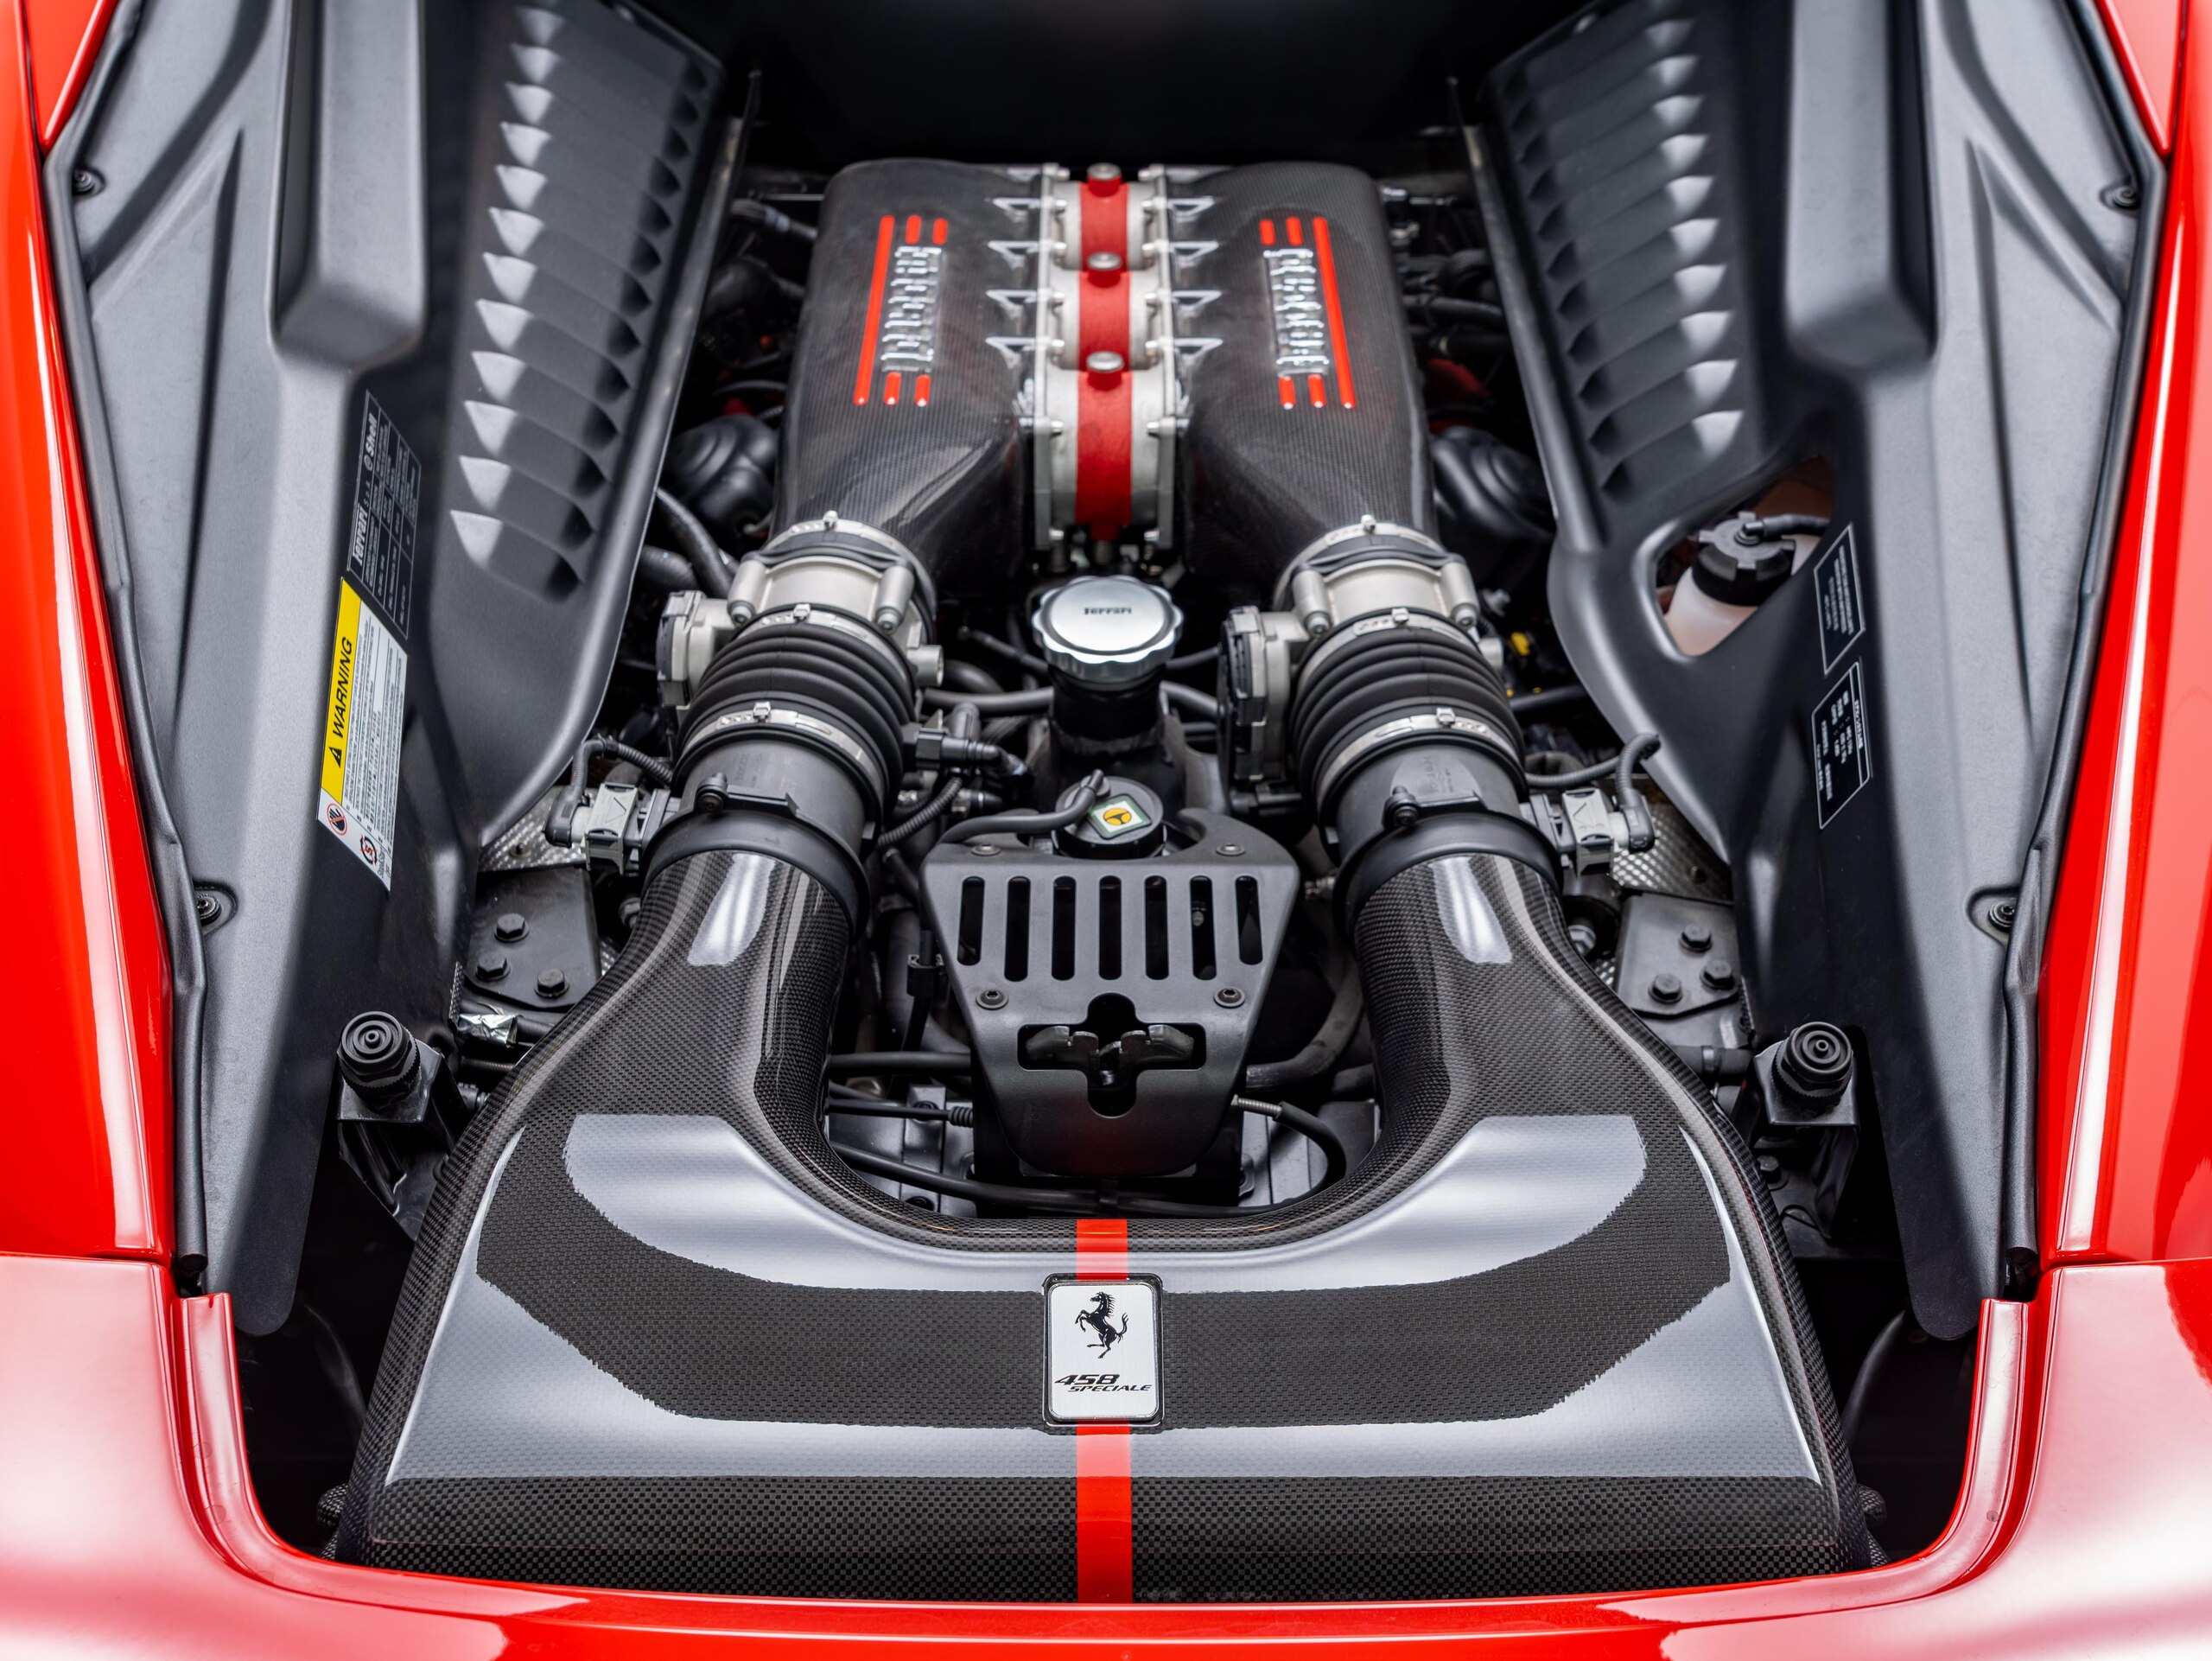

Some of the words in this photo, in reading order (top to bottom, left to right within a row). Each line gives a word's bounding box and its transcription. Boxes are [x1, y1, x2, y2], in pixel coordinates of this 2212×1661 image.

[352, 502, 368, 567] Ferrari
[365, 412, 378, 458] Shell
[332, 637, 353, 739] WARNING
[1054, 1374, 1120, 1385] 458
